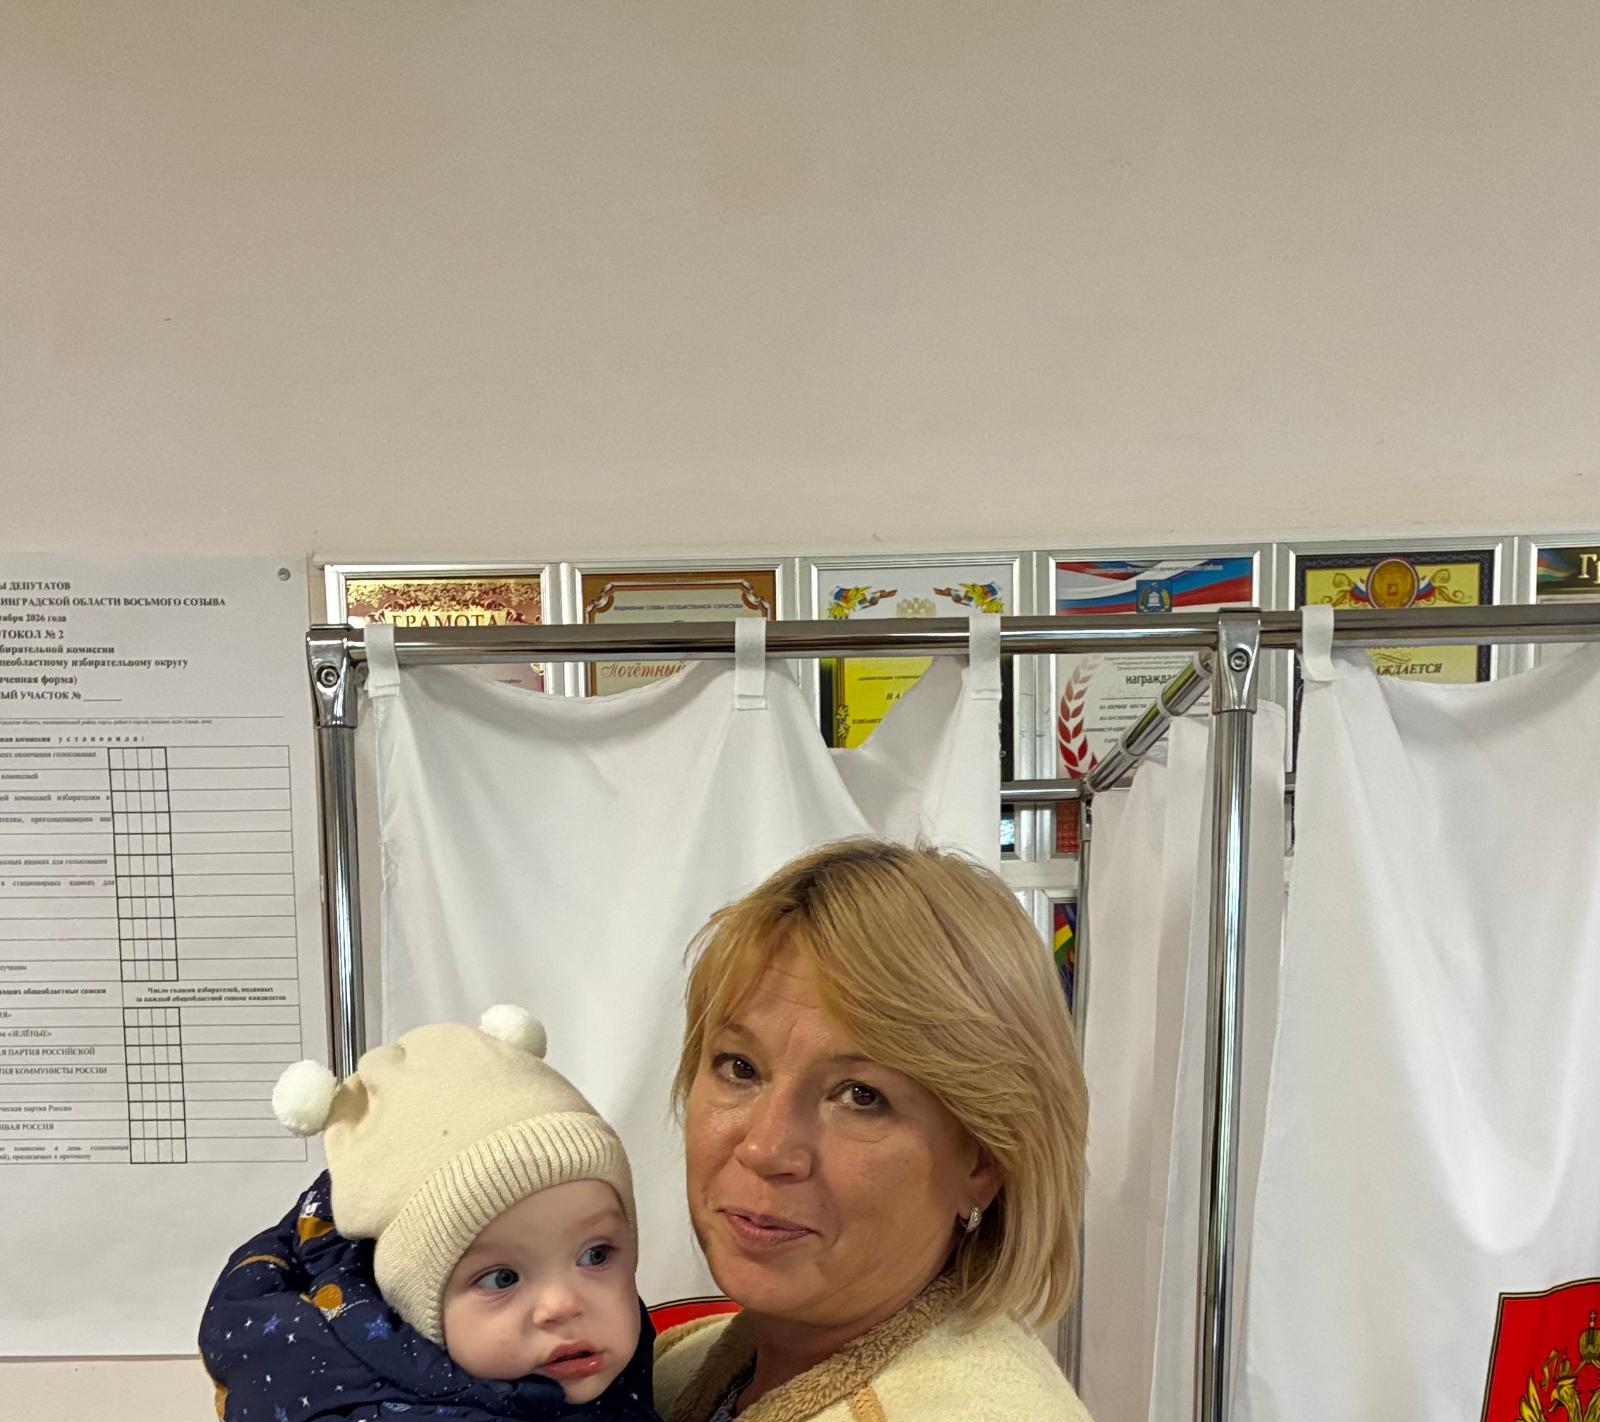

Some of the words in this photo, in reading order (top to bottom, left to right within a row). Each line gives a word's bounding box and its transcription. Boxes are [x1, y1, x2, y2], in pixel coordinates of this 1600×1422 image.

[9, 581, 71, 591] ДЕПУТАТОВ
[72, 597, 121, 606] ОБЛАСТИ
[123, 597, 182, 606] ВОСЬМОГО
[183, 597, 226, 606] СОЗЫВА
[25, 614, 45, 623] 2026
[47, 615, 67, 623] года
[58, 630, 64, 639] 2
[66, 646, 115, 654] комиссии
[71, 657, 152, 669] избирательному
[154, 659, 188, 669] округу
[40, 674, 77, 686] форма)
[20, 691, 70, 700] УЧАСТОК
[8, 1048, 40, 1056] ПАРТИЯ
[42, 1046, 96, 1056] РОССИЙСКОЙ
[15, 1067, 73, 1075] КОММУНИСТЫ
[22, 1123, 54, 1131] РОССИЯ
